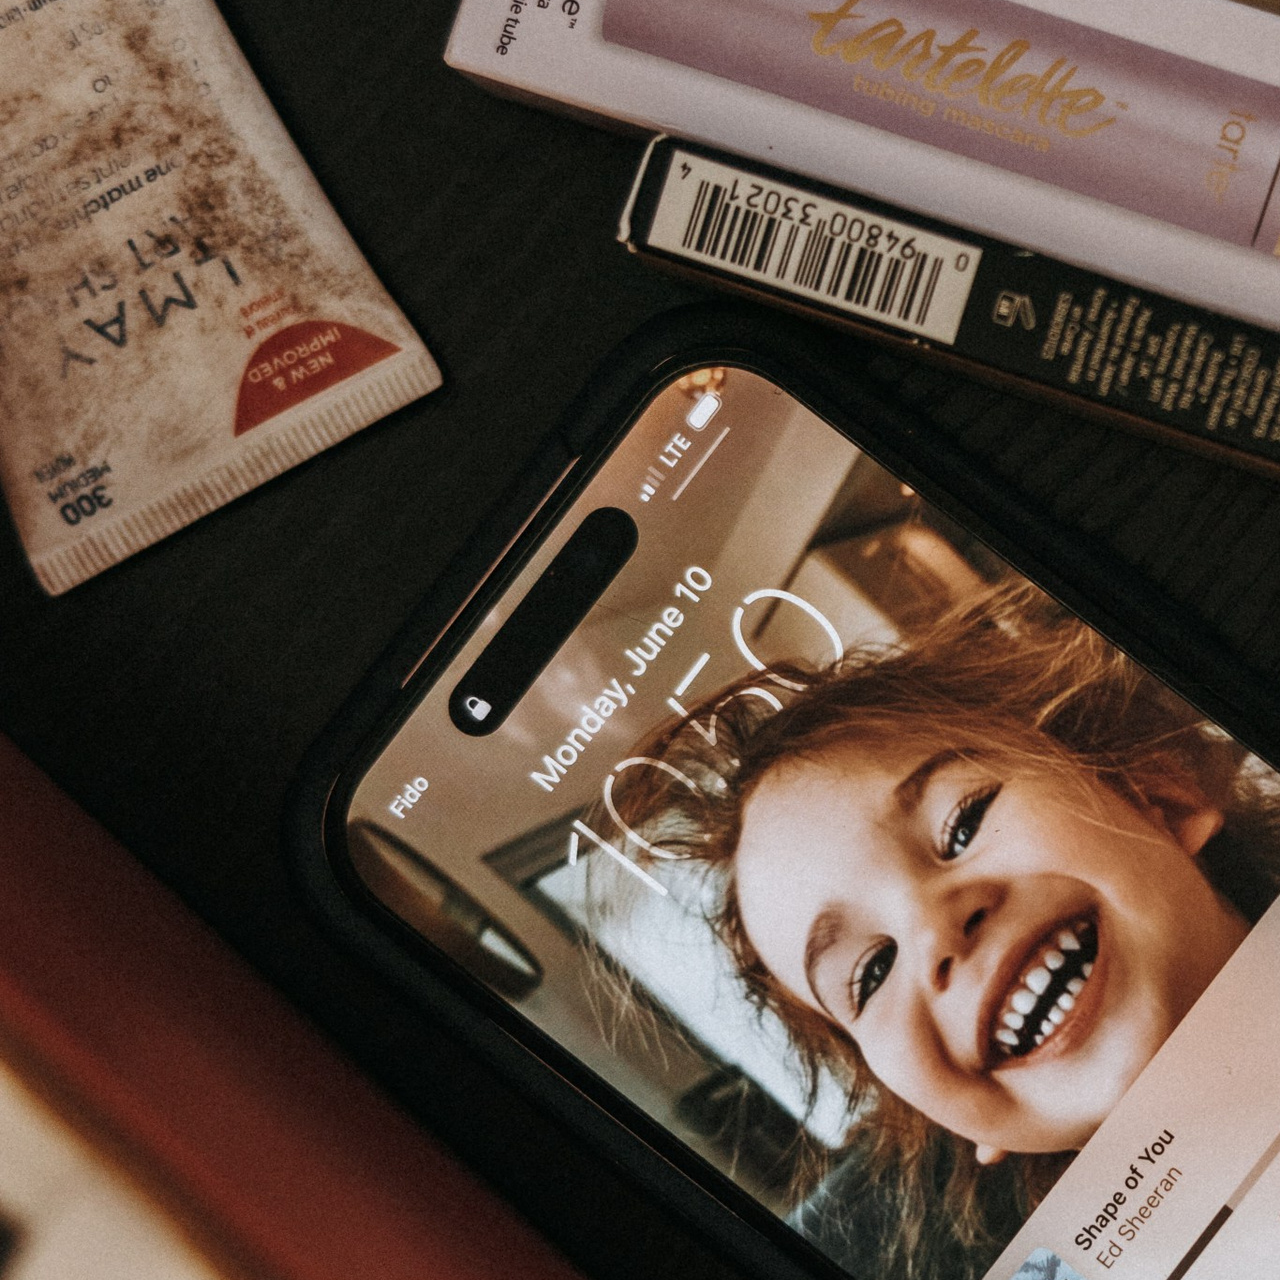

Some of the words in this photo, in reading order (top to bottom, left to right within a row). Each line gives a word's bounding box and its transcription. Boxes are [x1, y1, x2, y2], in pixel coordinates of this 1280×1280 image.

[495, 17, 520, 56] tube
[680, 162, 692, 180] 4
[728, 178, 818, 227] 33021
[828, 211, 918, 260] 94800
[954, 252, 970, 272] 0
[60, 241, 242, 379] LMAY
[248, 326, 341, 383] IMPROVED
[290, 352, 334, 382] NEW
[272, 376, 286, 390] &
[659, 433, 692, 468] LTE
[59, 484, 113, 526] 300
[530, 678, 636, 792] Monday,
[624, 606, 685, 677] June
[674, 565, 713, 603] 10
[388, 776, 429, 819] Fido
[1074, 1191, 1127, 1251] Shape
[1124, 1164, 1144, 1191] of
[1137, 1129, 1175, 1165] You
[1095, 1239, 1124, 1270] Ed
[1117, 1166, 1183, 1242] Sheeran
